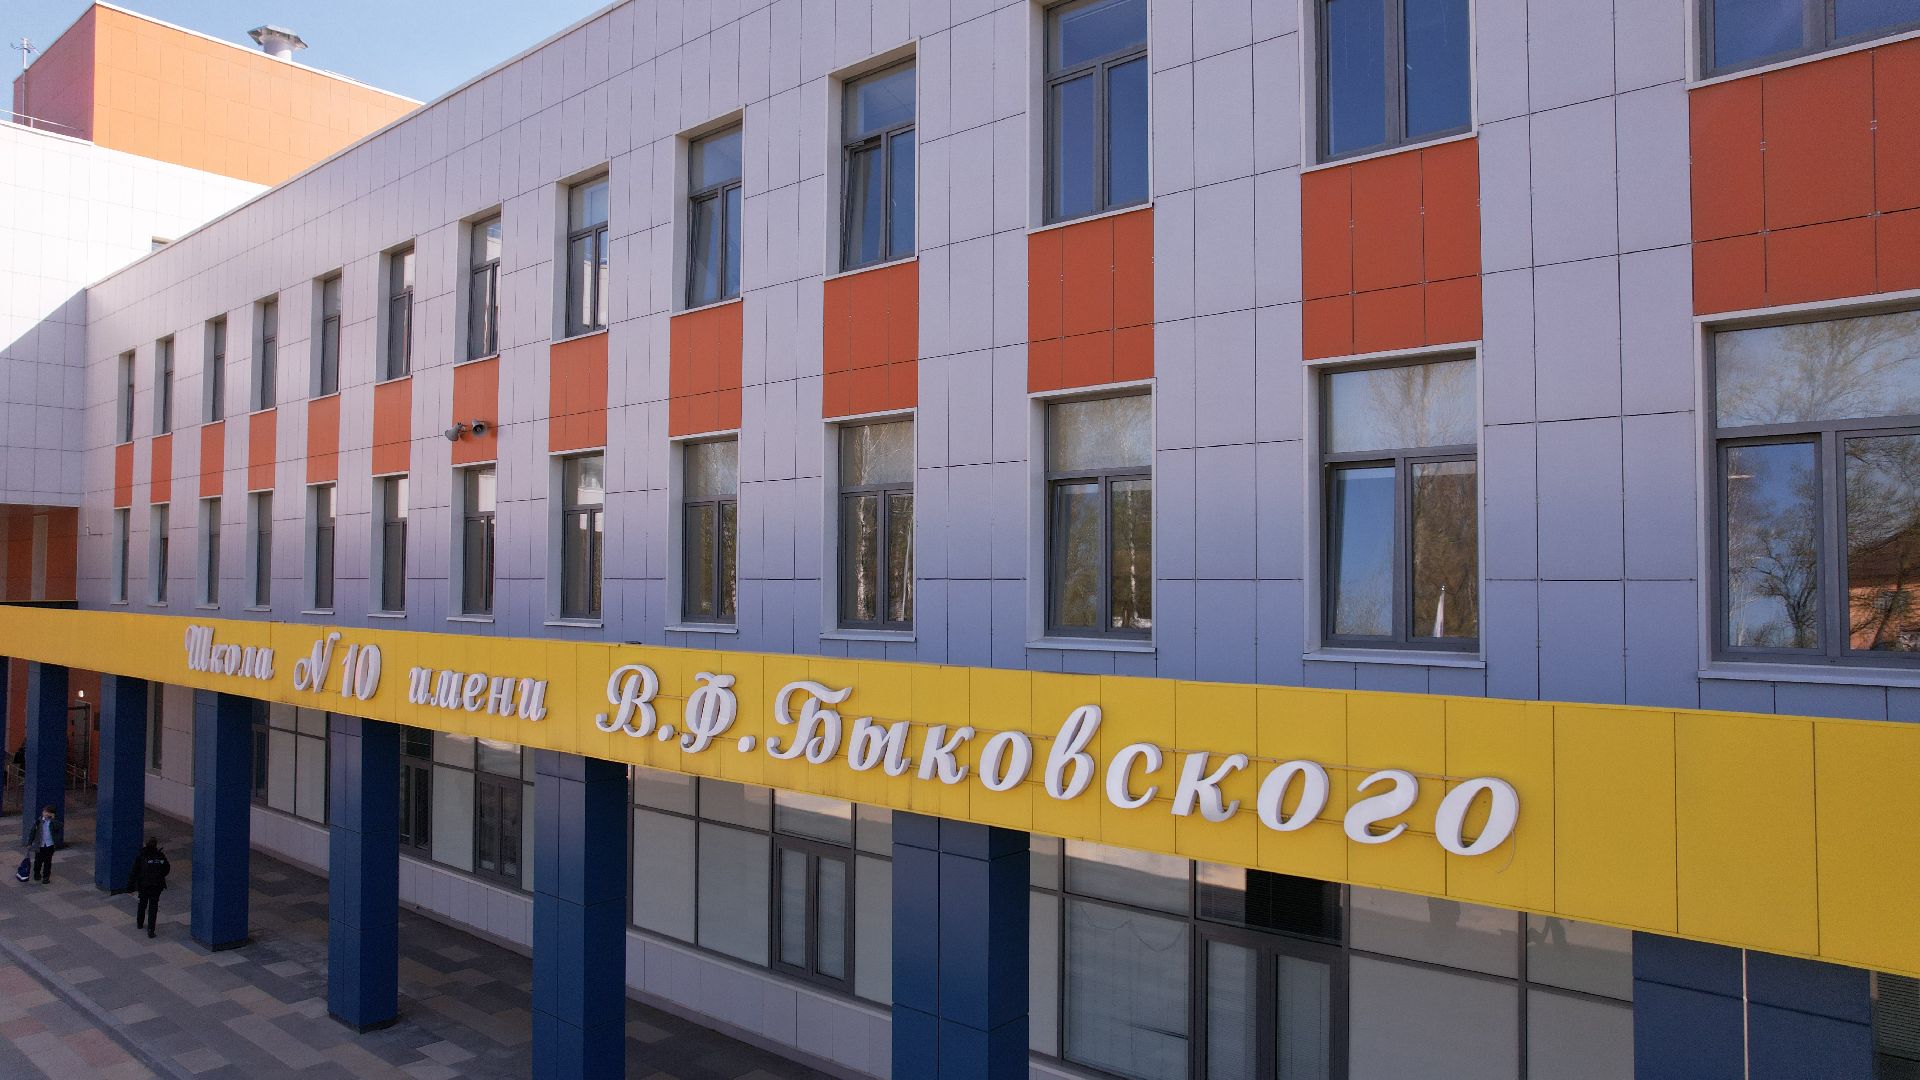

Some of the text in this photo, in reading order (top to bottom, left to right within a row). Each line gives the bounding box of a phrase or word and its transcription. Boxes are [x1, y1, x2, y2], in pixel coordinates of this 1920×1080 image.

[184, 624, 274, 681] Школа
[341, 643, 382, 702] 10
[408, 666, 547, 721] имени
